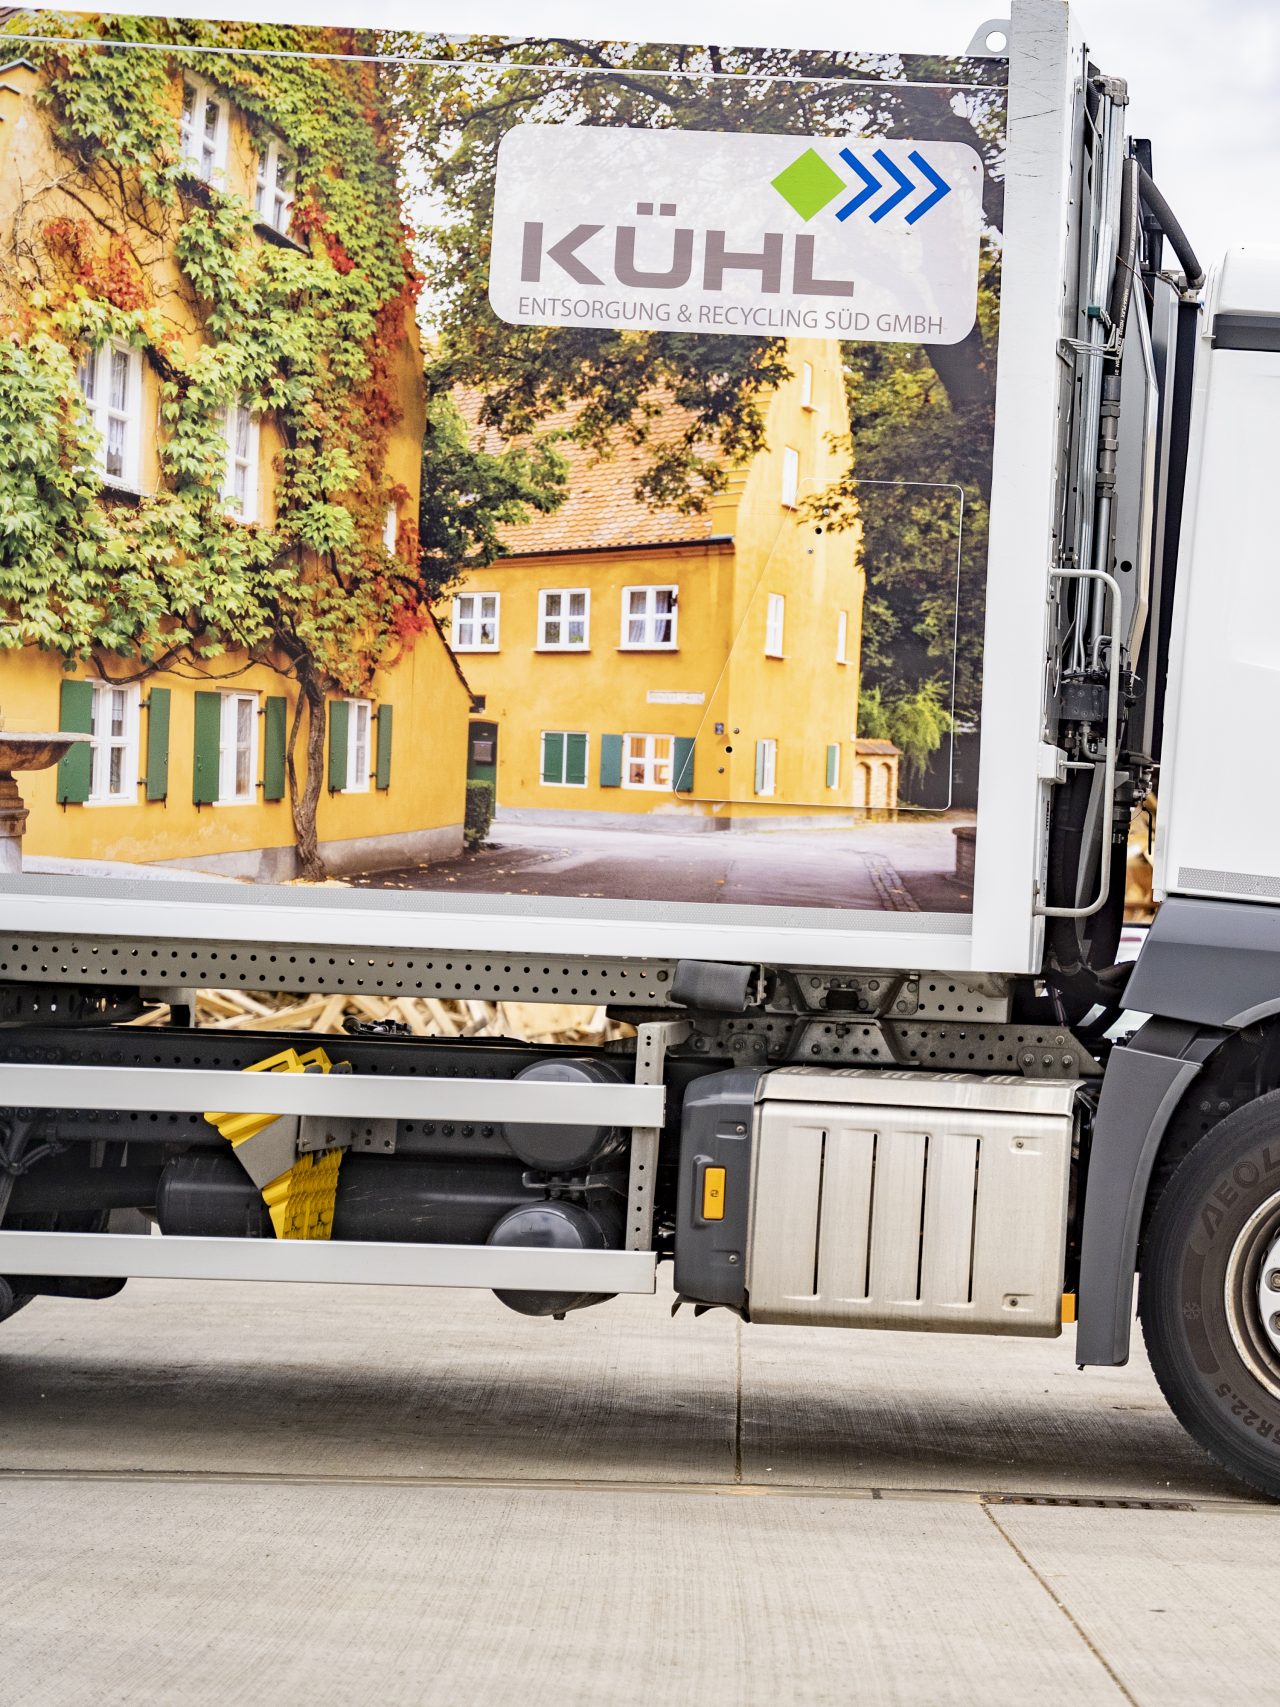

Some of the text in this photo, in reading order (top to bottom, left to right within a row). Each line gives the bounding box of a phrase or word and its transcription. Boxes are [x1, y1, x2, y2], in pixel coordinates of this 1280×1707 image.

[520, 202, 855, 297] KÜHL
[518, 296, 944, 335] ENTSORGUNG & RECYCLING SÜD GMBH
